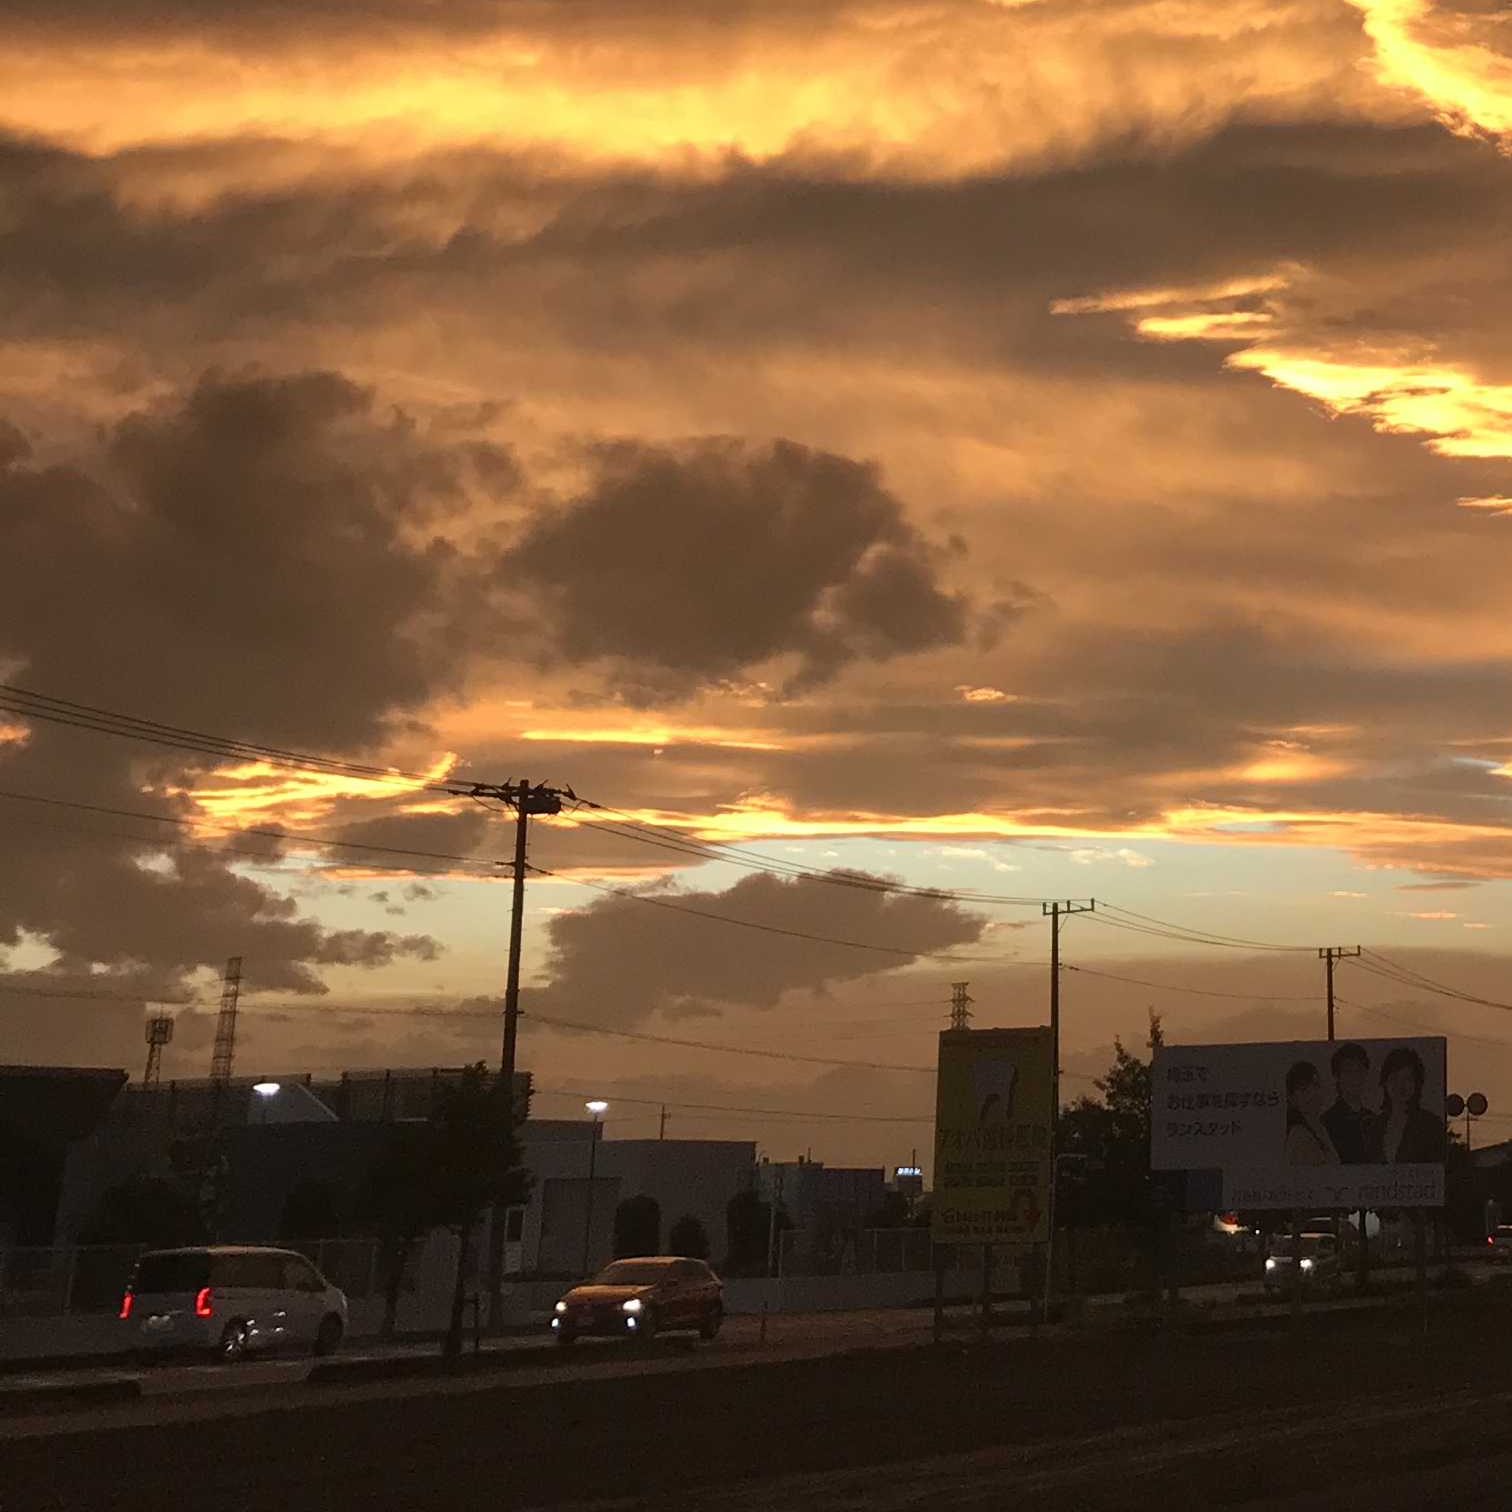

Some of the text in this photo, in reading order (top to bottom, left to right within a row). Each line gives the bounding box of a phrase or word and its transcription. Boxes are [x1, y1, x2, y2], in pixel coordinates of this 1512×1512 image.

[1166, 1119, 1242, 1138] ランスタッド
[1357, 1180, 1436, 1200] randstad
